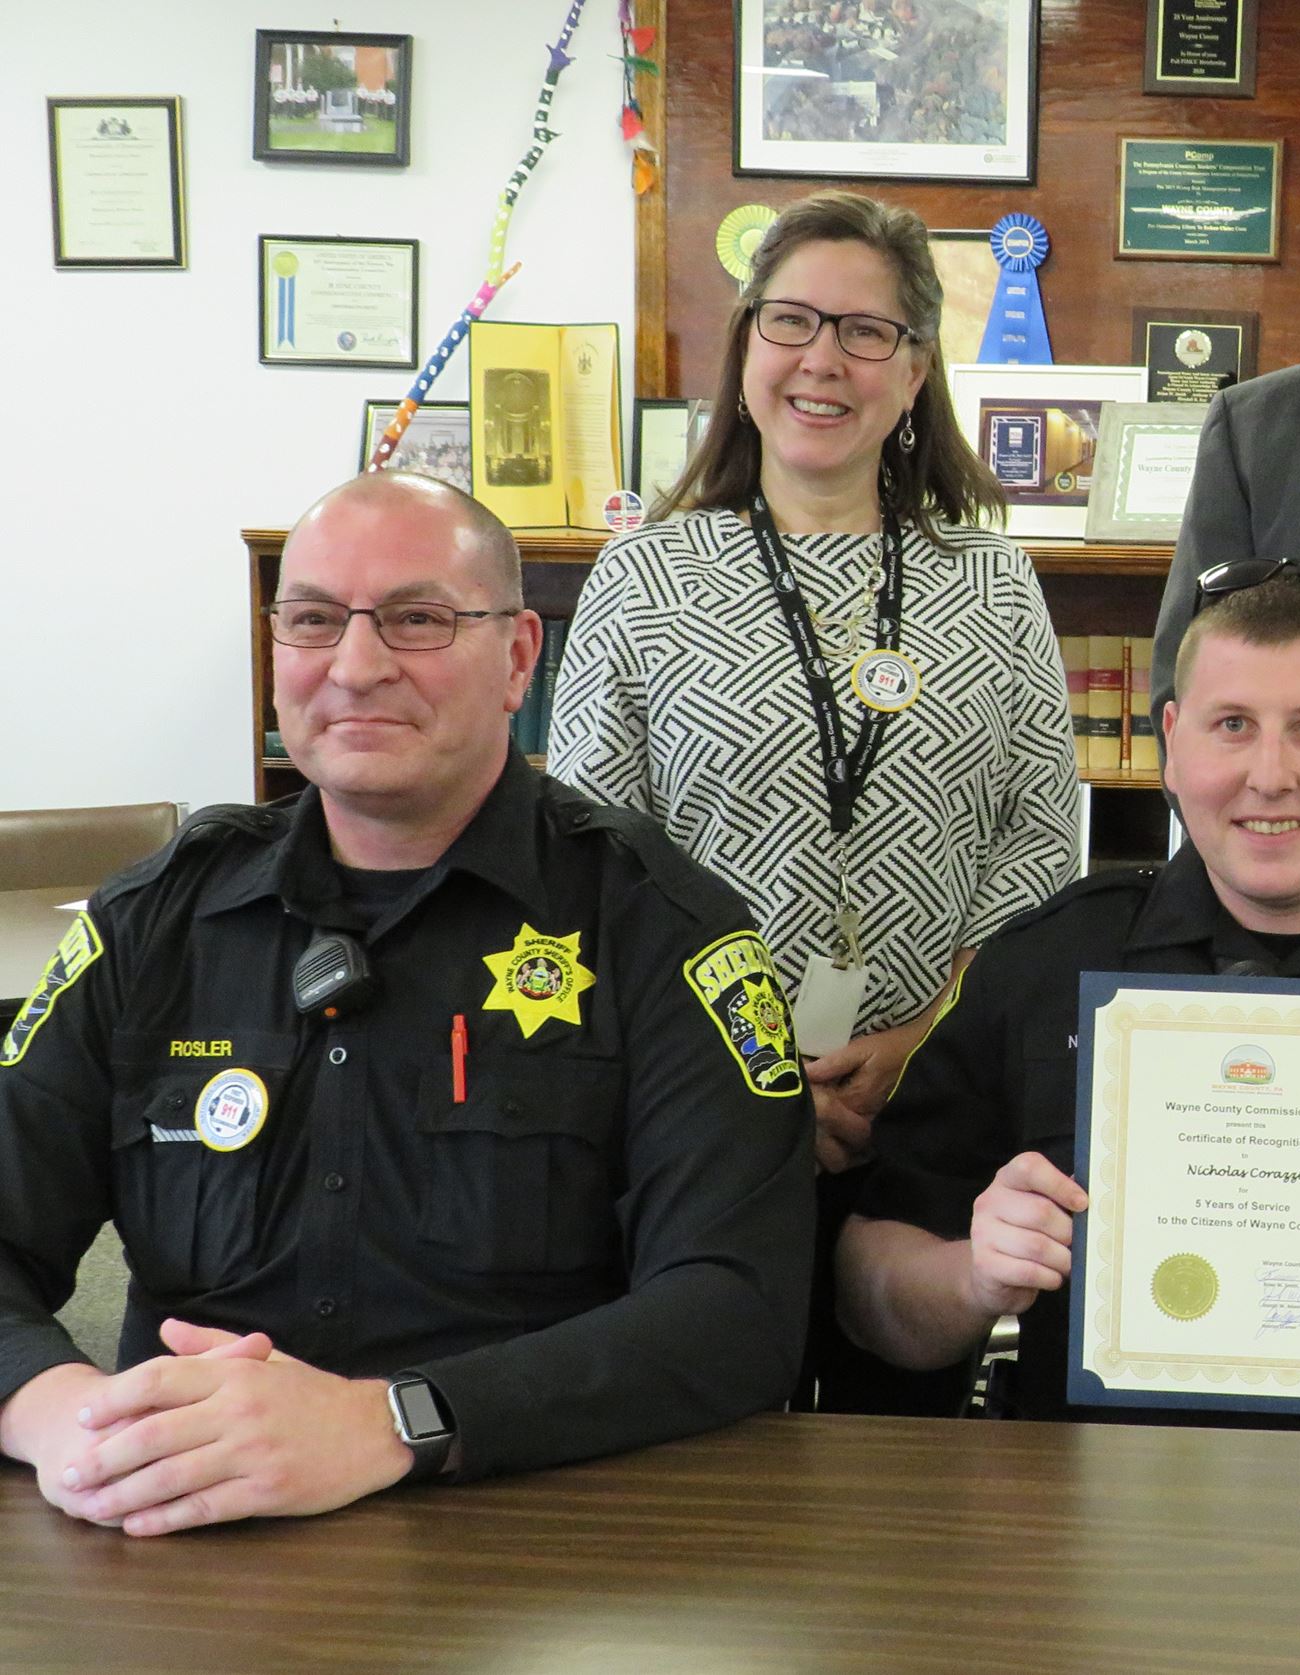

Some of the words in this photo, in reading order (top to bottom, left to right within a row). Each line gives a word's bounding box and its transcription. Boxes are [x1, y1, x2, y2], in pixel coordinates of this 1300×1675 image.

[1196, 14, 1228, 22] Anniversary
[1179, 32, 1198, 40] Wayne
[1161, 204, 1195, 215] WAYNE
[1196, 205, 1234, 216] COUNTY
[1137, 464, 1163, 474] Wayne
[1165, 465, 1191, 474] County
[879, 674, 895, 687] 911
[822, 701, 829, 710] PA
[524, 938, 573, 953] SHERIFF
[512, 948, 541, 966] COUNTY
[544, 949, 573, 975] SHERIFF'S
[505, 968, 514, 994] WAYNE
[556, 978, 574, 1003] OFFICE
[170, 1041, 232, 1056] ROSLER
[221, 1103, 238, 1119] 911
[1165, 1101, 1201, 1114] Wayne
[1204, 1103, 1242, 1115] County
[1178, 1132, 1232, 1144] Certificate
[1235, 1136, 1246, 1144] of
[1186, 1164, 1248, 1178] Nicholas
[1195, 1199, 1201, 1208] 5
[1205, 1200, 1234, 1210] Years
[1238, 1201, 1248, 1210] of
[1251, 1201, 1290, 1212] Service
[1158, 1216, 1168, 1224] to
[1171, 1216, 1187, 1225] the
[1191, 1217, 1233, 1227] Citizens
[1236, 1218, 1247, 1228] of
[1250, 1220, 1285, 1232] Wayne
